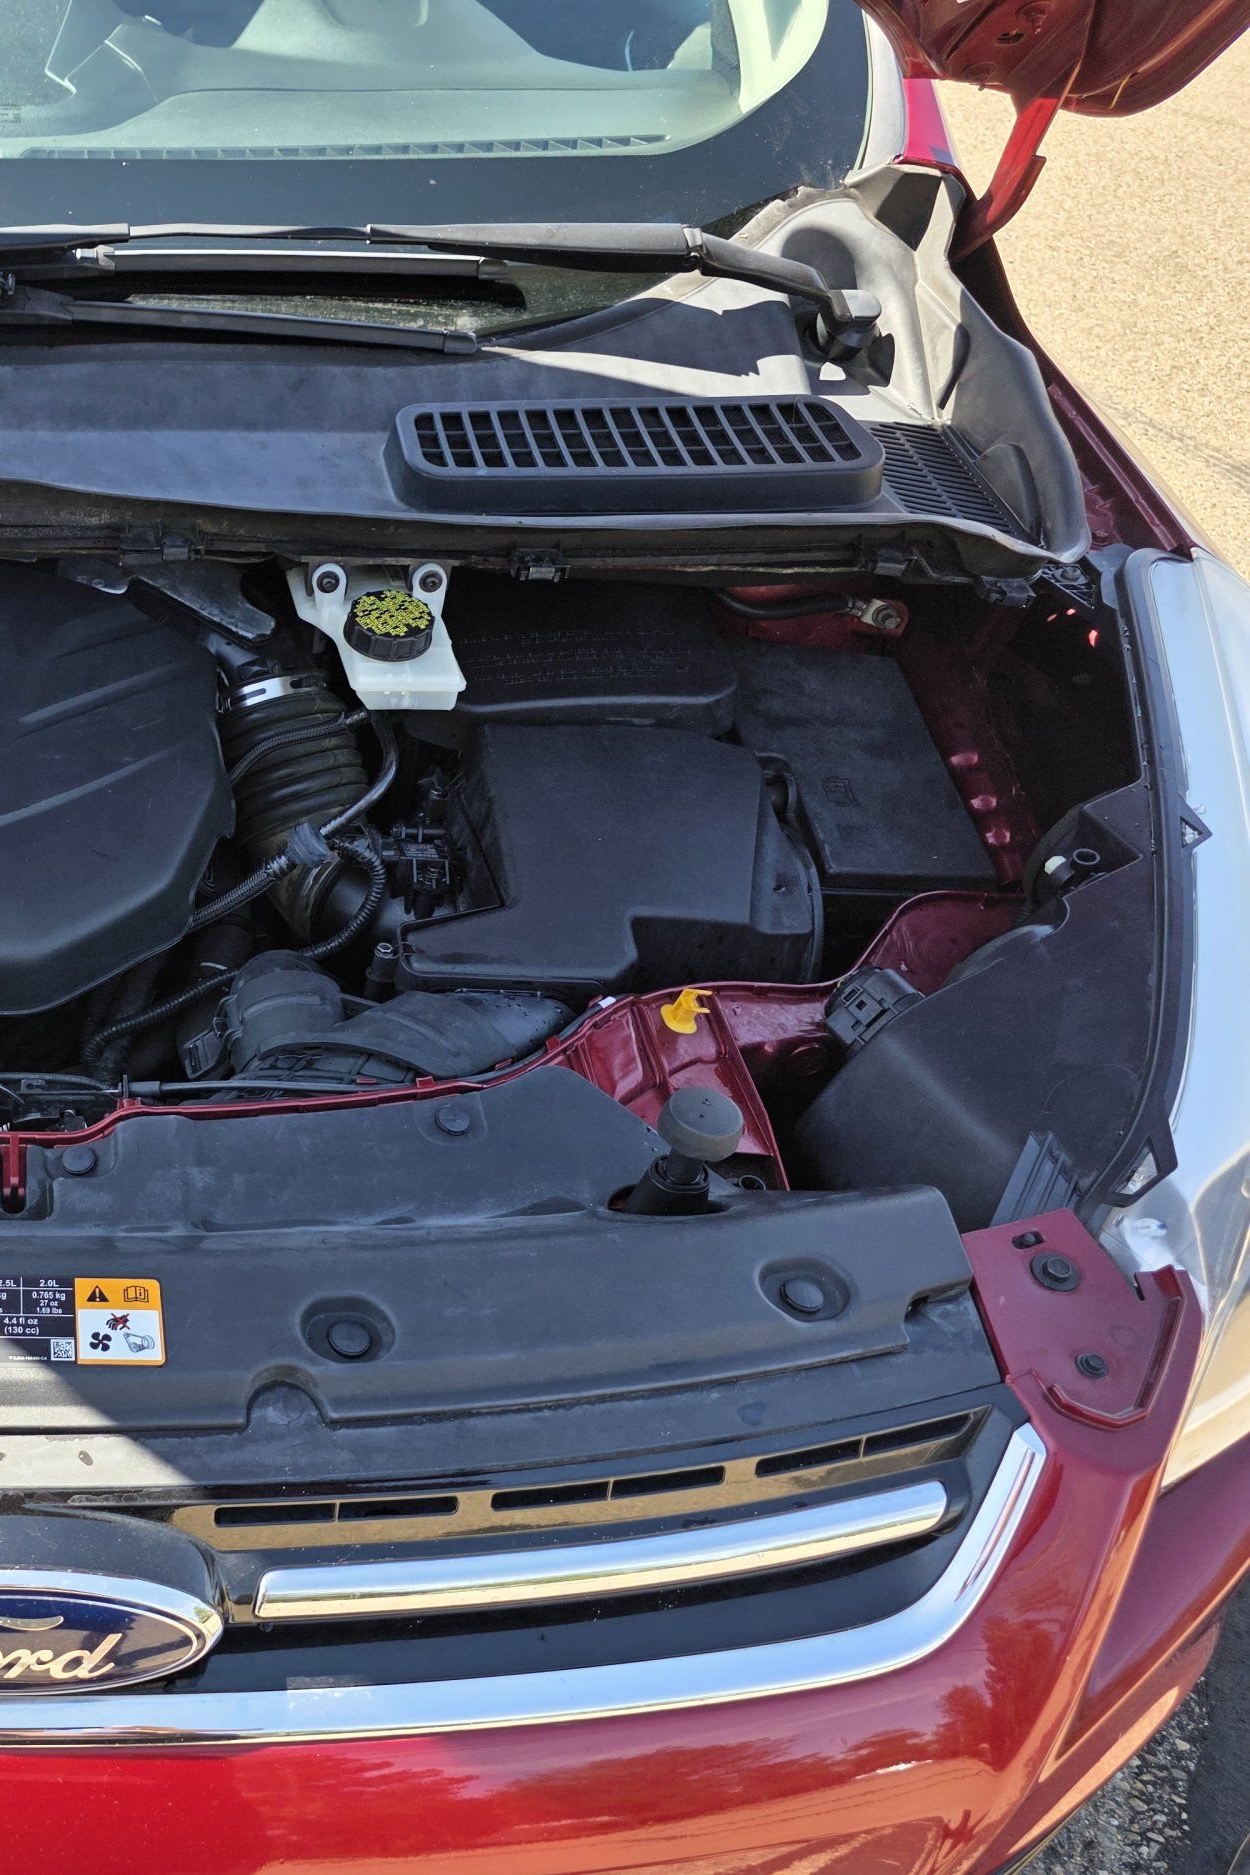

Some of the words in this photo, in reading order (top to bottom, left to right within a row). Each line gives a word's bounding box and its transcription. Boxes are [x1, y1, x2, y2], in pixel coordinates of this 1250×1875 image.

[39, 1279, 59, 1287] 2.0L
[32, 1291, 53, 1299] 0.765
[55, 1291, 66, 1300] kg
[4, 1326, 24, 1335] (130
[25, 1327, 40, 1335] cc)
